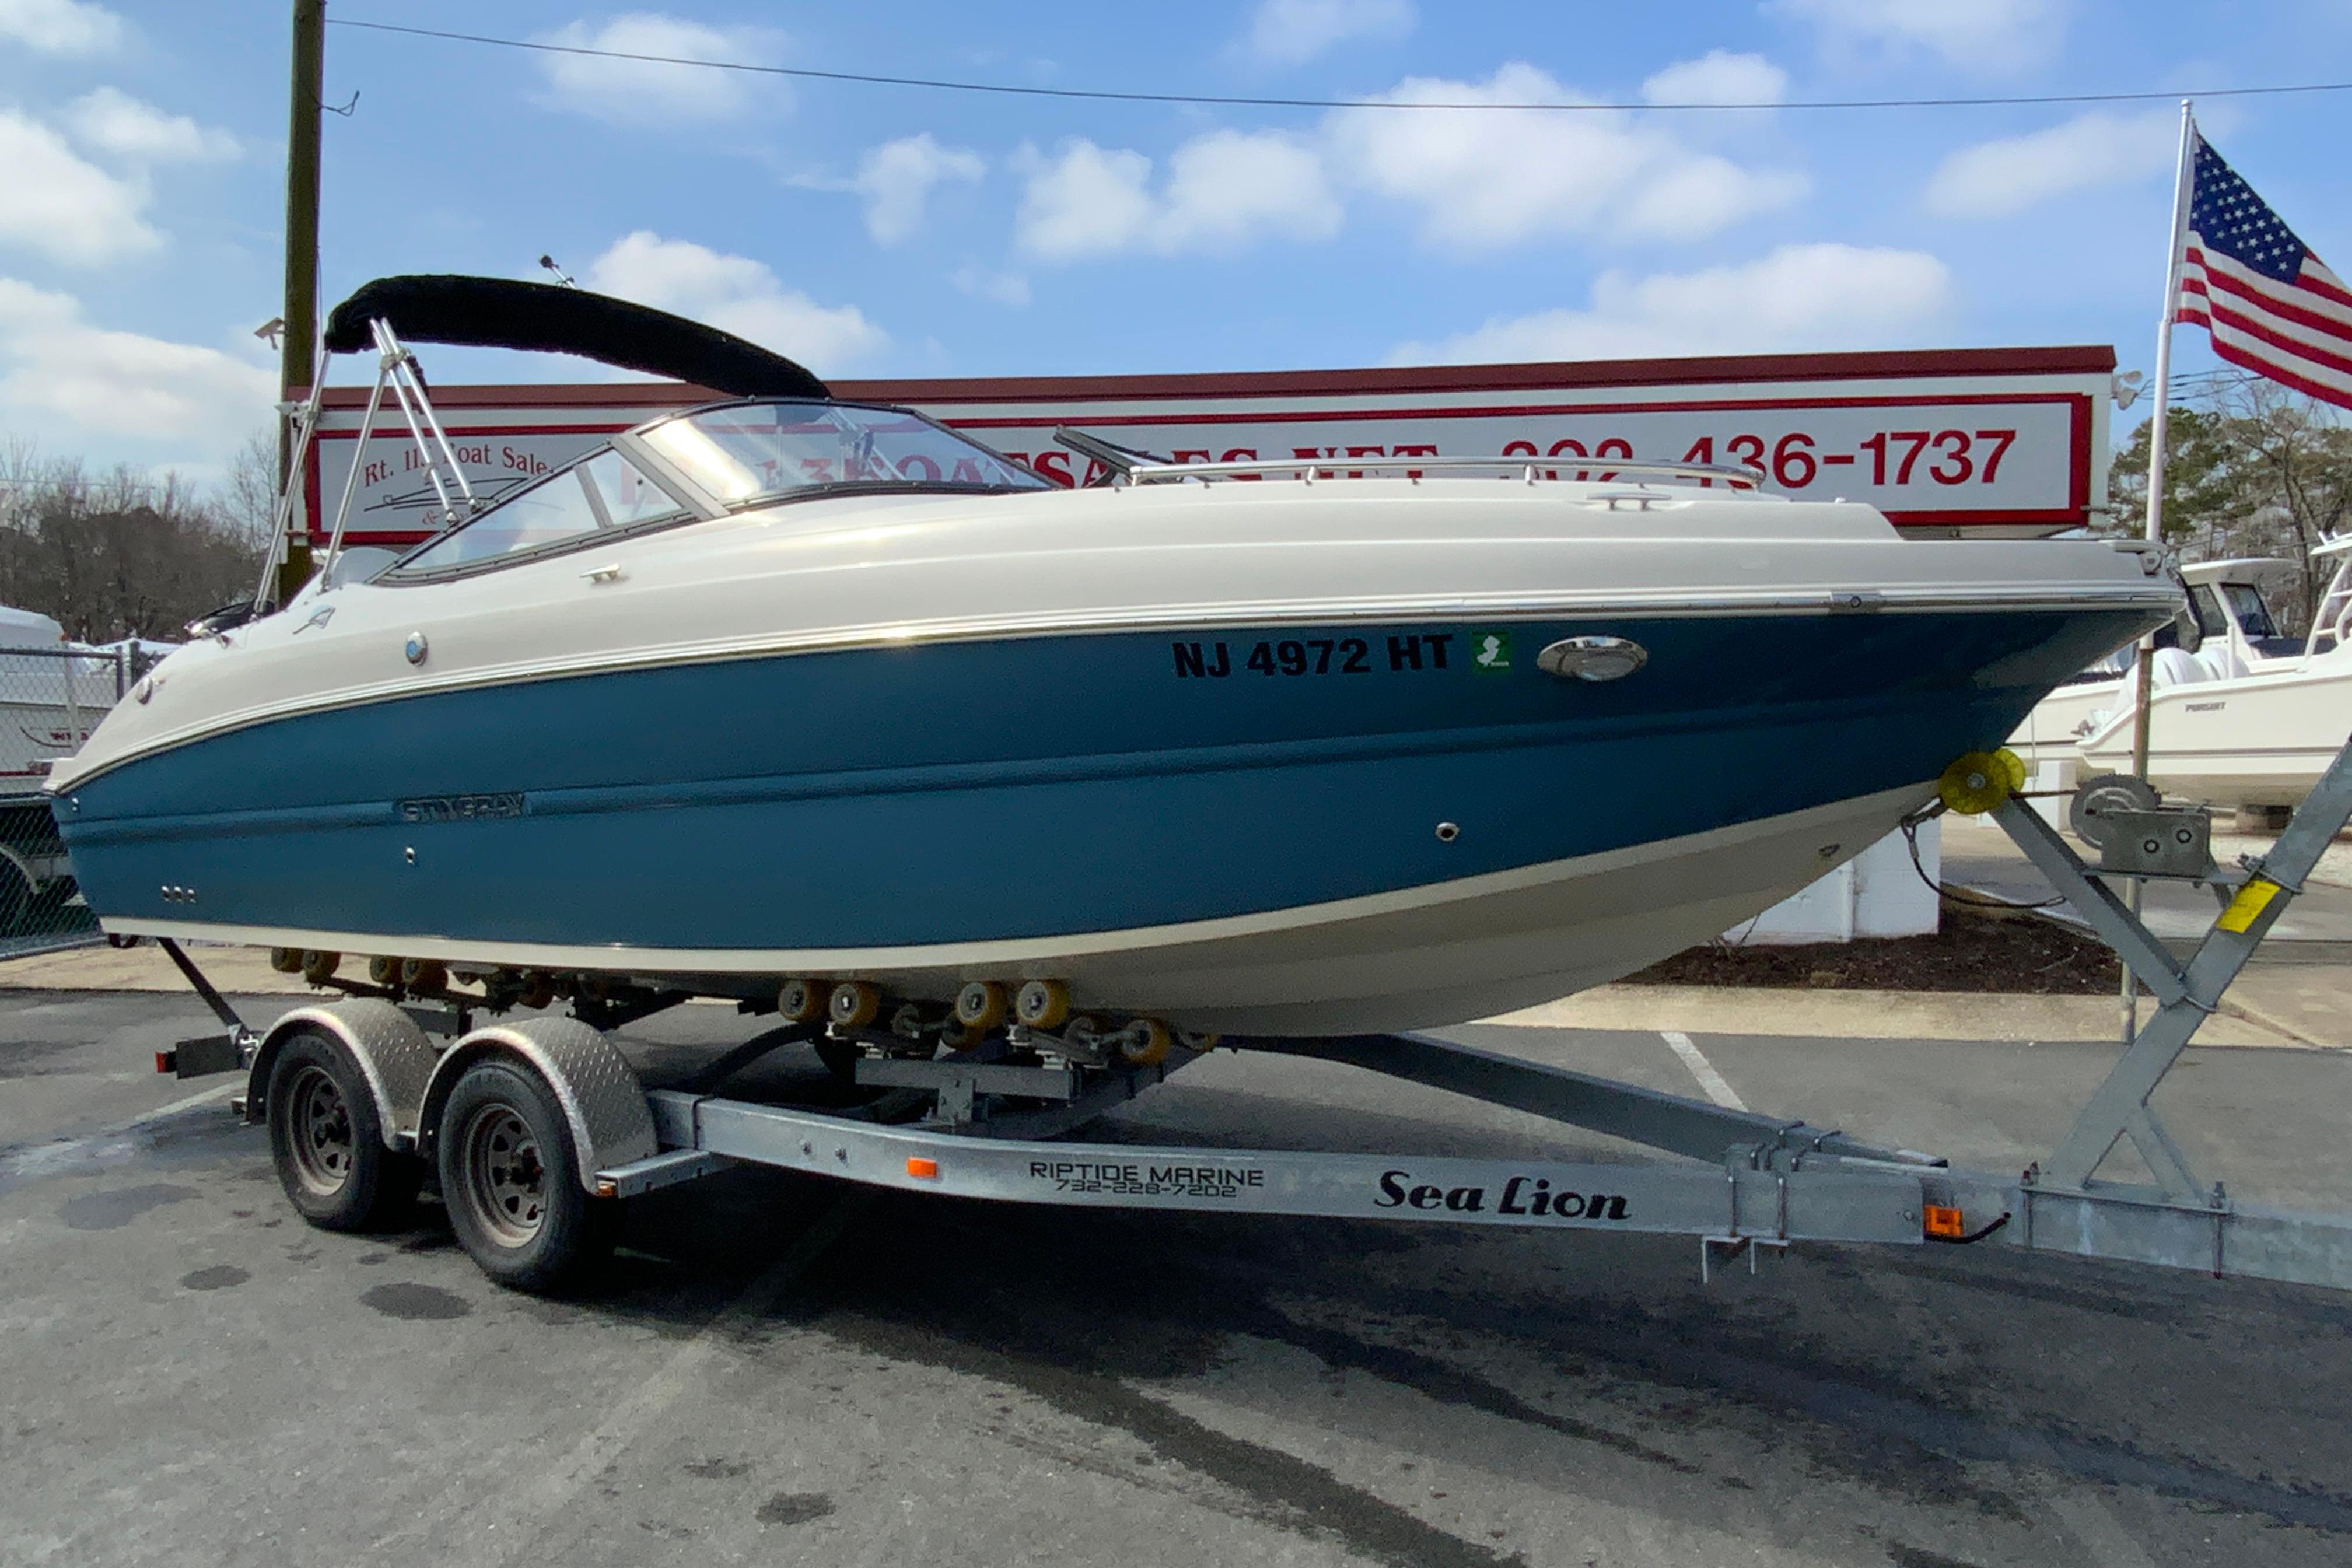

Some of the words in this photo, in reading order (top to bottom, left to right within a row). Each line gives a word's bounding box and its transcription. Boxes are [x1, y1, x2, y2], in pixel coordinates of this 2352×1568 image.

[365, 459, 394, 488] Rt.
[1172, 640, 1231, 679] NJ
[1247, 636, 1372, 677] 4972
[1387, 633, 1453, 671] HT
[2185, 702, 2227, 713] PURSUIT
[1030, 1161, 1139, 1183] RIPTIDE
[1149, 1166, 1264, 1188] MARINE
[1055, 1179, 1237, 1199] 732-228-7202
[1373, 1170, 1485, 1212] Sea
[1497, 1175, 1632, 1220] Lion
